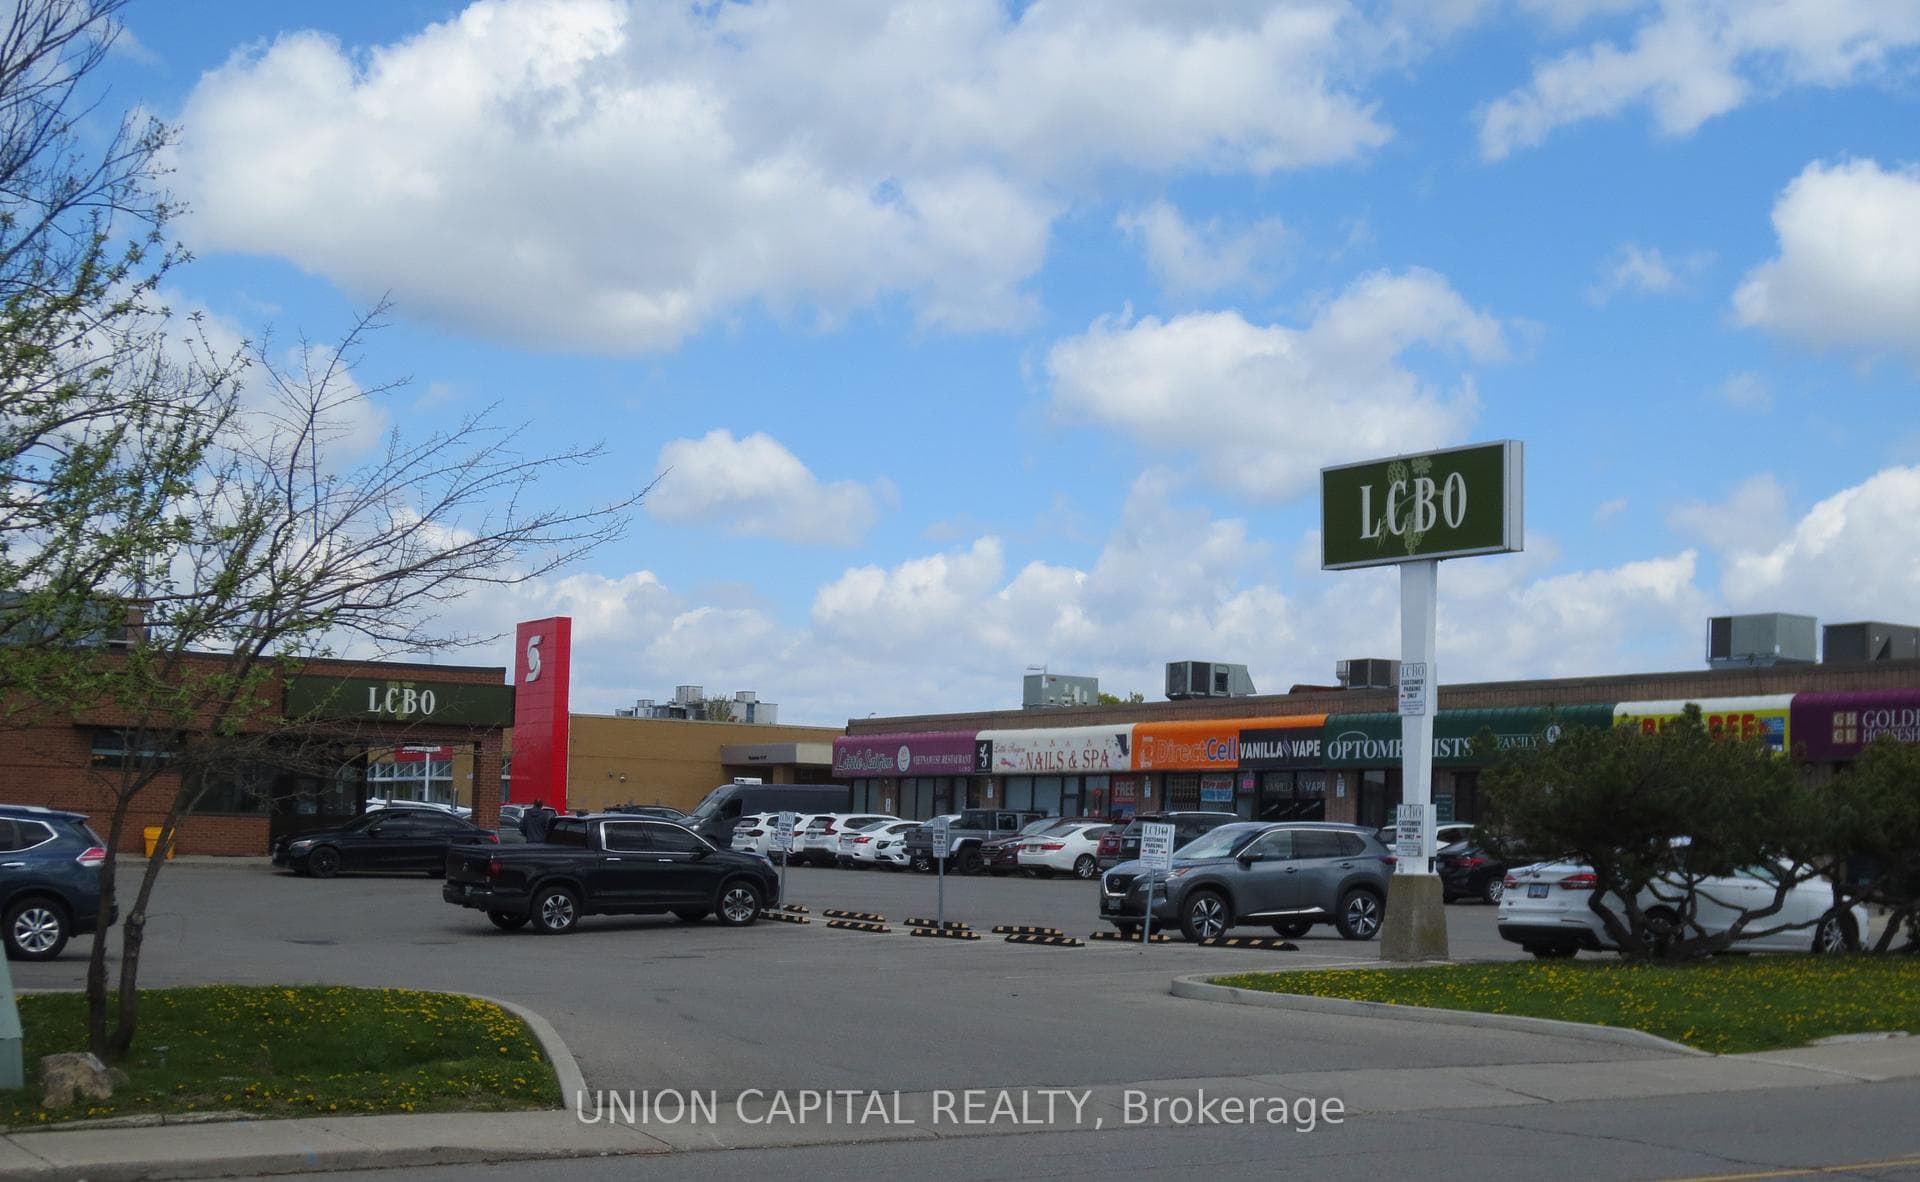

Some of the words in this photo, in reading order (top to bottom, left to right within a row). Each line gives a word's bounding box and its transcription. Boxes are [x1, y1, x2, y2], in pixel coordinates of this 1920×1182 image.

[1360, 472, 1467, 539] LCBO
[368, 687, 435, 715] LCBO
[1025, 750, 1064, 771] NAILS
[1068, 750, 1078, 769] &
[1082, 748, 1109, 769] SPA
[1240, 742, 1283, 760] VANILLA
[1292, 740, 1320, 757] VAPE
[1115, 781, 1135, 796] FREE
[1305, 780, 1327, 792] VAPE
